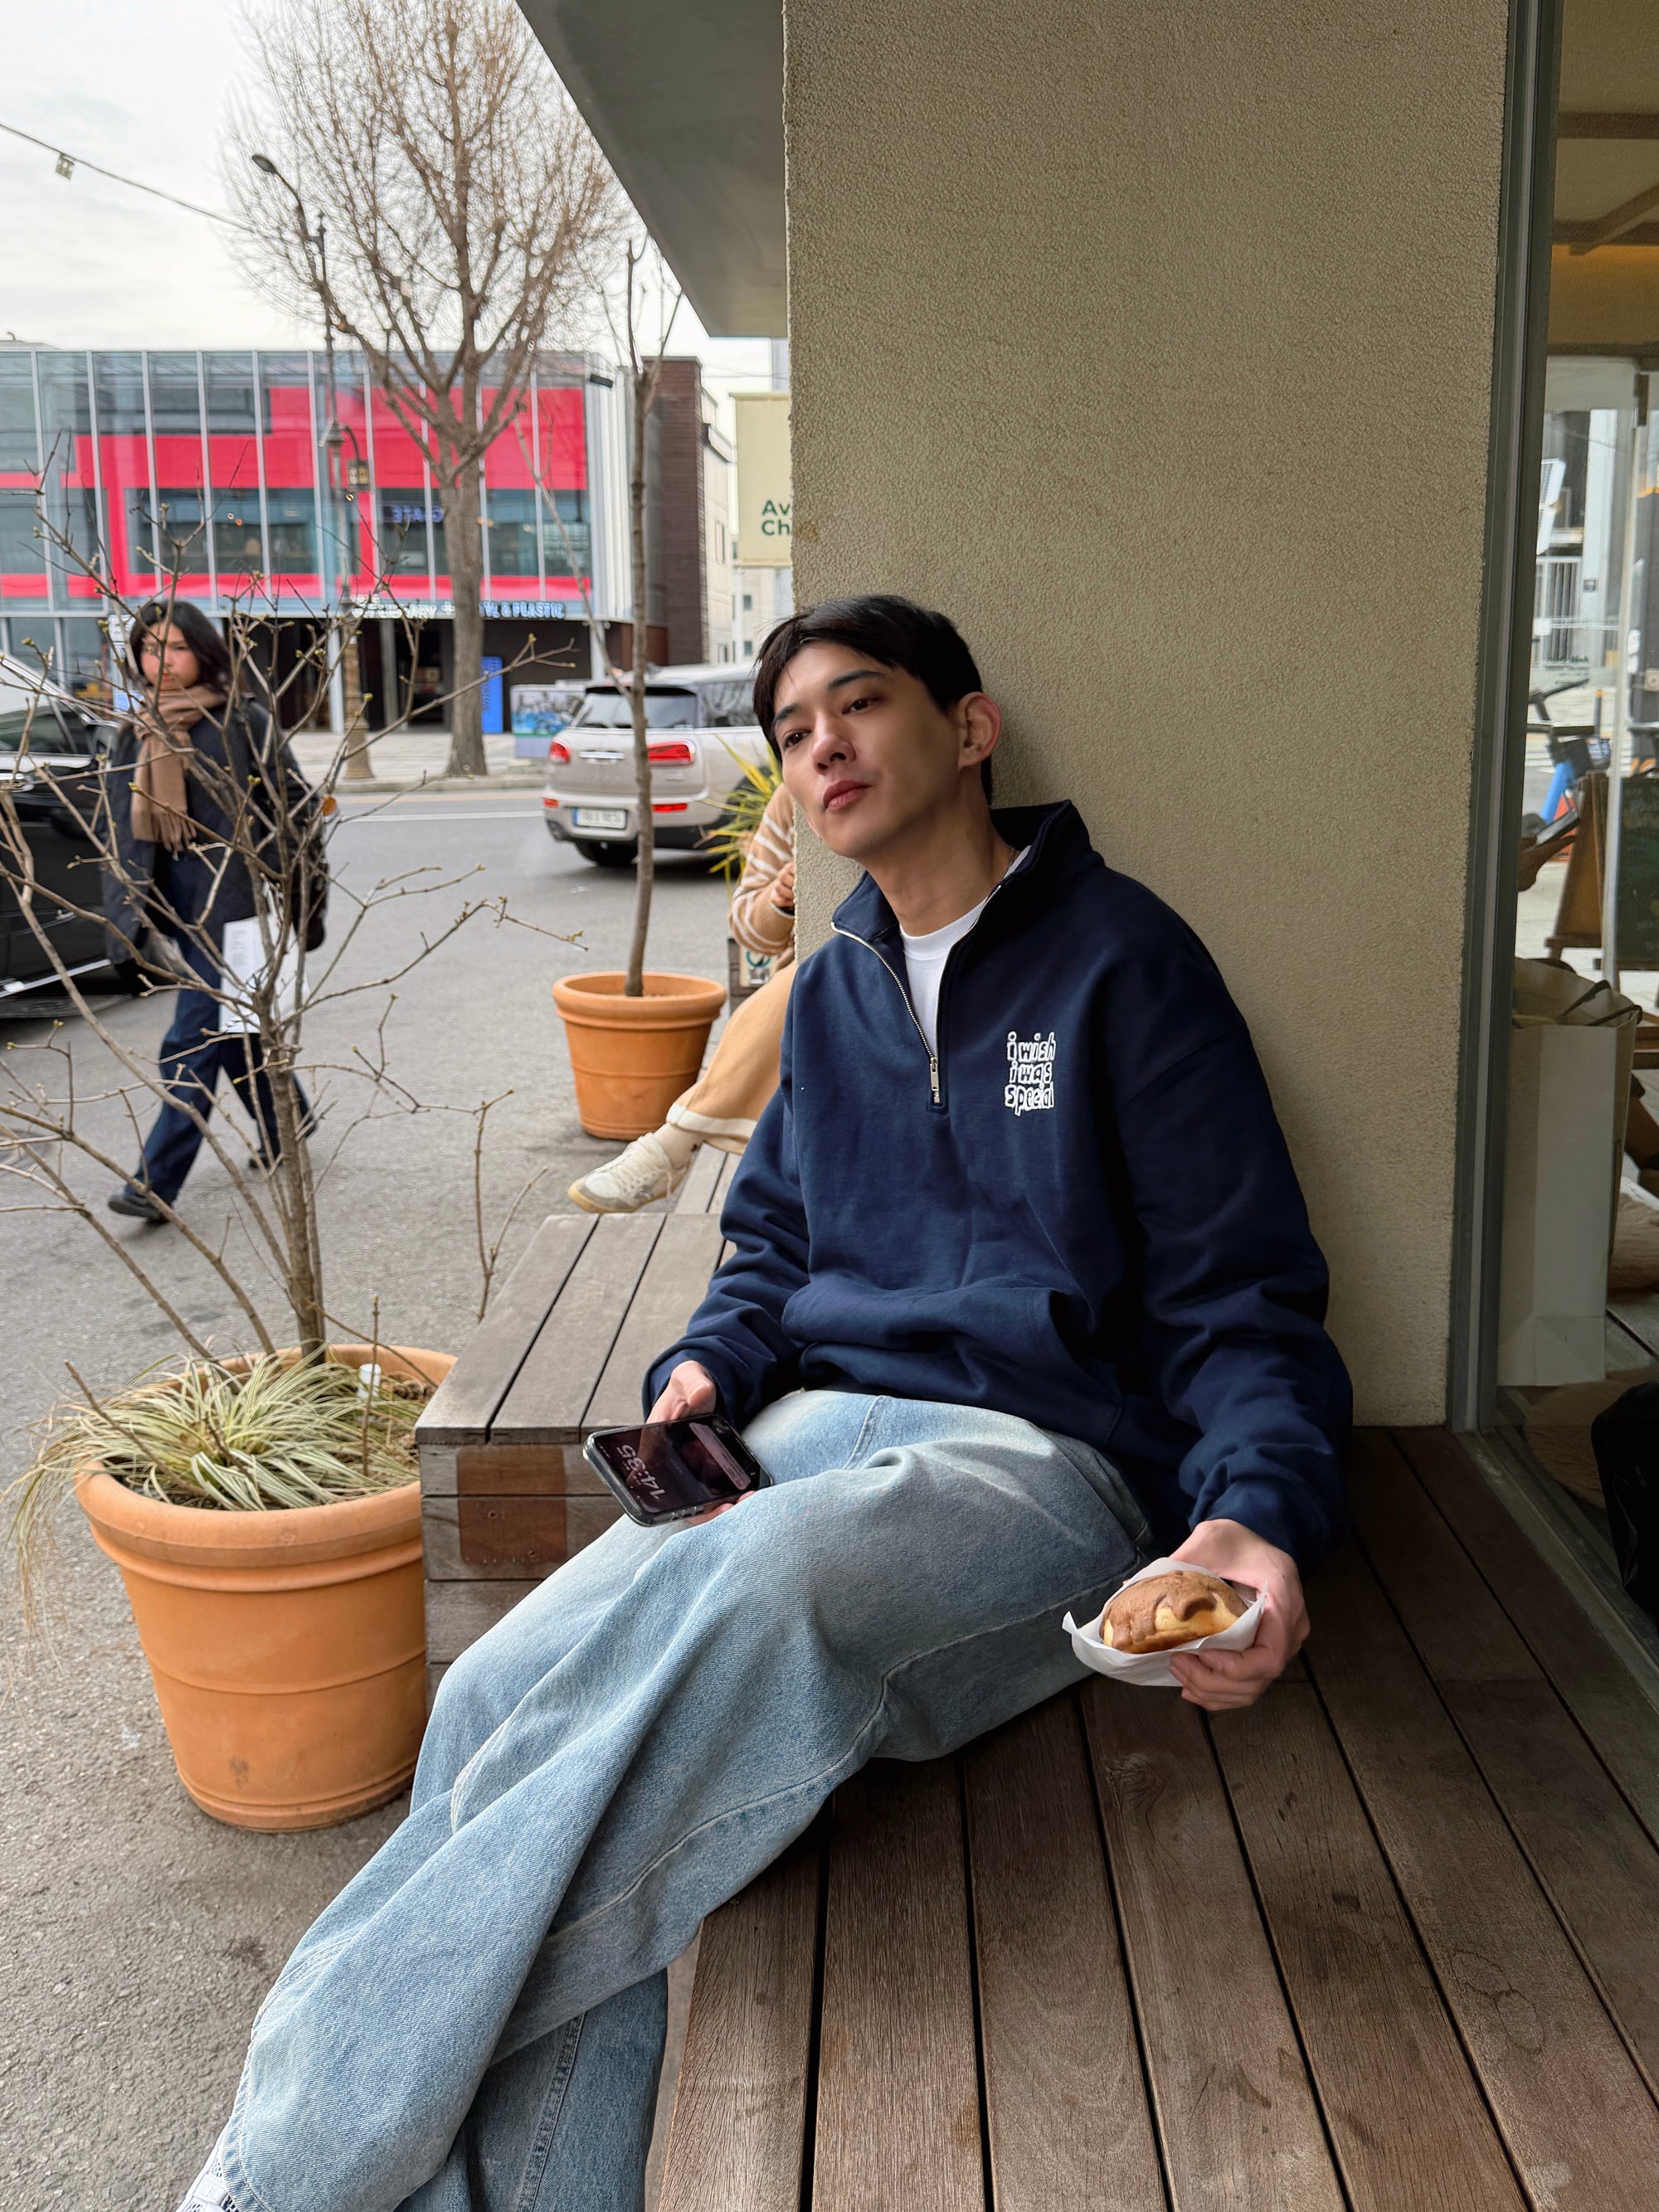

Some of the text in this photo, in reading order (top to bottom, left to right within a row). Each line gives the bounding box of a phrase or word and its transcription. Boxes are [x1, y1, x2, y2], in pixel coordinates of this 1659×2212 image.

[761, 499, 791, 516] Av
[761, 518, 791, 536] Ch
[512, 601, 565, 620] PLASTIC
[1018, 1032, 1056, 1062] wish
[1018, 1062, 1053, 1085] was
[1005, 1082, 1054, 1116] special
[616, 1444, 665, 1499] 14:35
